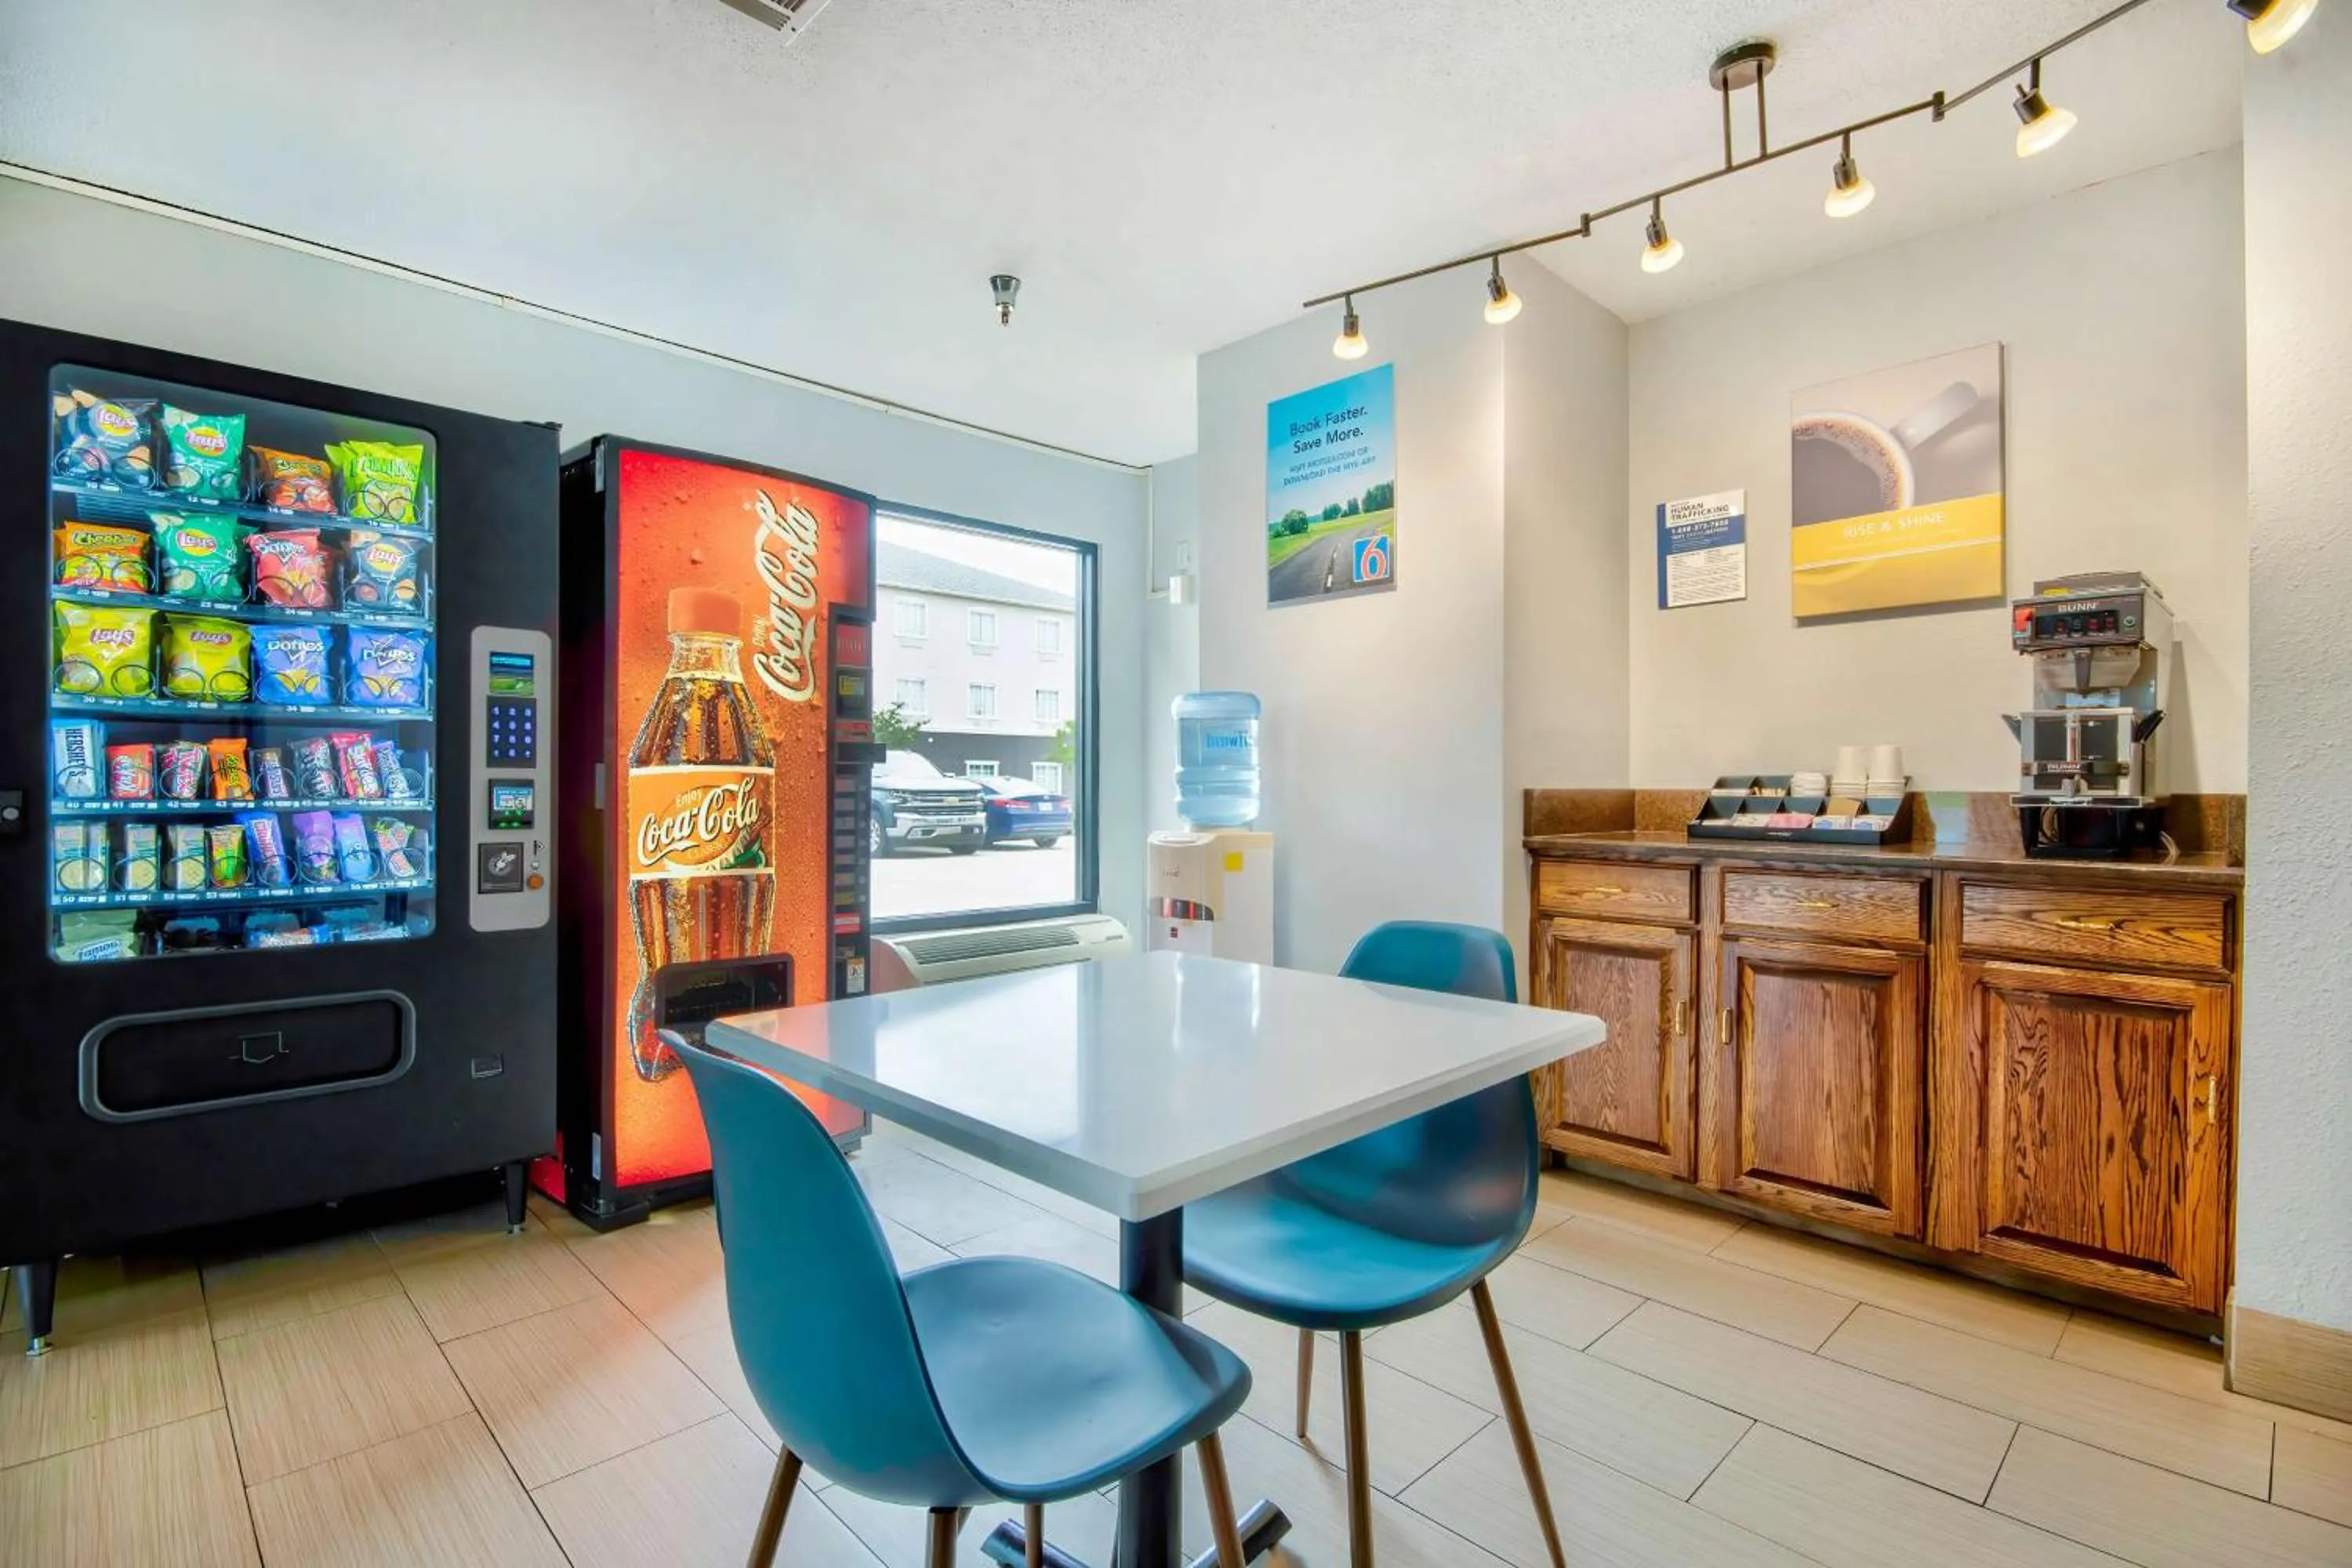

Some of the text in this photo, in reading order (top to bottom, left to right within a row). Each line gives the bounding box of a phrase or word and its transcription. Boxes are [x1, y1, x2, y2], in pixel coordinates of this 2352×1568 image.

[1289, 405, 1368, 438] Book Faster.
[1293, 426, 1364, 455] Save More.
[1671, 501, 1704, 514] HUMAN
[1671, 503, 1730, 521] TRAFFICKING
[1843, 524, 1875, 539] RISE
[1897, 513, 1946, 532] SHINE
[1360, 535, 1388, 583] 6
[753, 488, 819, 702] Coca-Cola
[2058, 601, 2096, 613] BUNN
[637, 775, 760, 868] Coca-Cola
